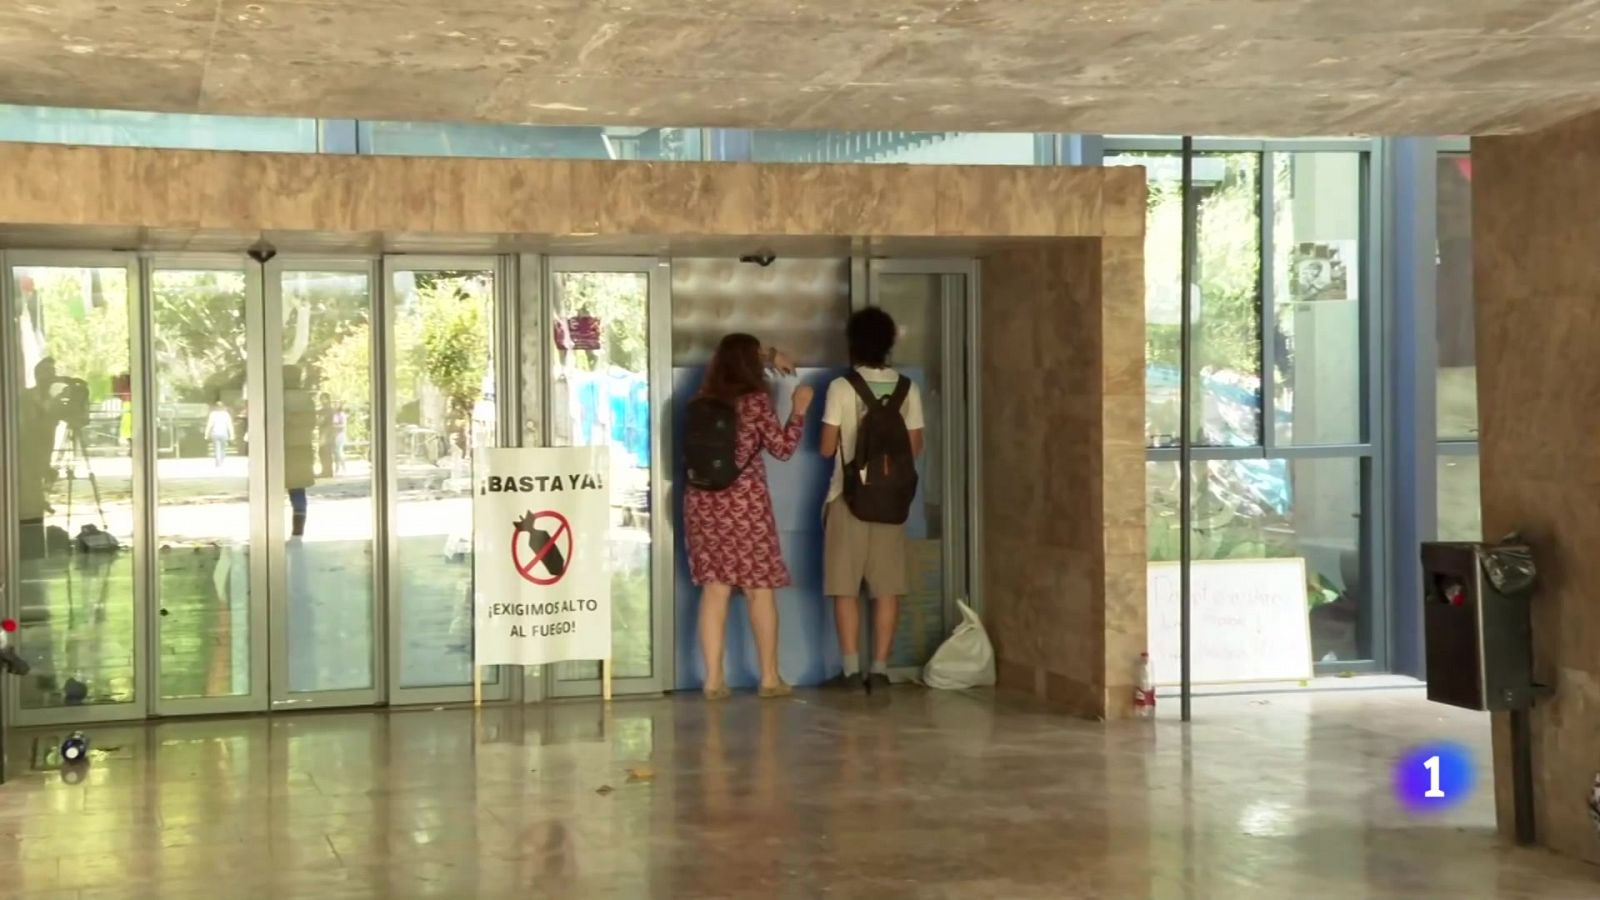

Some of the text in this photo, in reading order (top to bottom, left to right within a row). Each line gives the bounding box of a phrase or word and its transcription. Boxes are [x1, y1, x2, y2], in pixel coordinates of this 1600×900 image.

[480, 473, 603, 495] ¡BASTA YA!
[488, 599, 598, 618] ¡EXIGIMOS ALTO
[510, 621, 576, 637] AL FUEGO!
